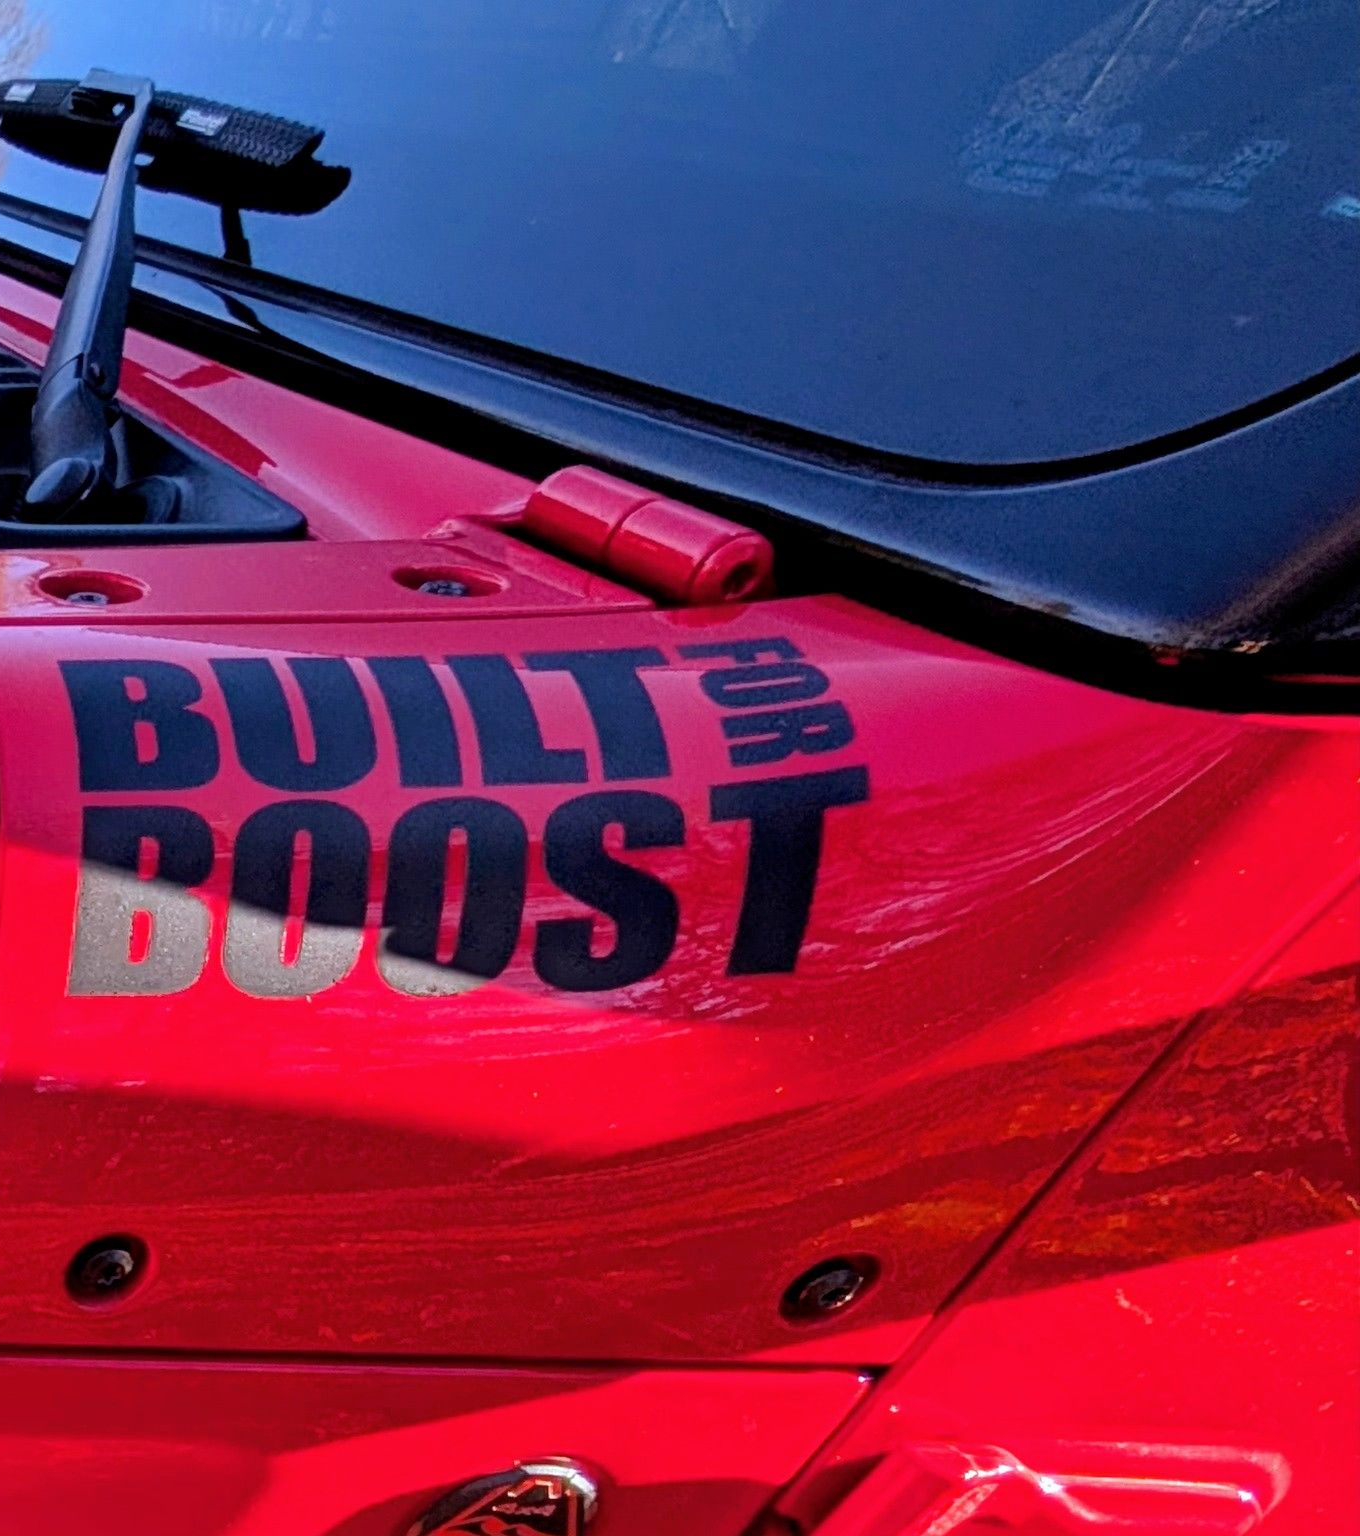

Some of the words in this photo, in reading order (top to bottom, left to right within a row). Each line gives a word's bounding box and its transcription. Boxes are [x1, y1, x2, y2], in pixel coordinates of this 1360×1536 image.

[56, 646, 671, 791] BUILT
[674, 636, 856, 767] FOR
[65, 765, 871, 998] BOOST
